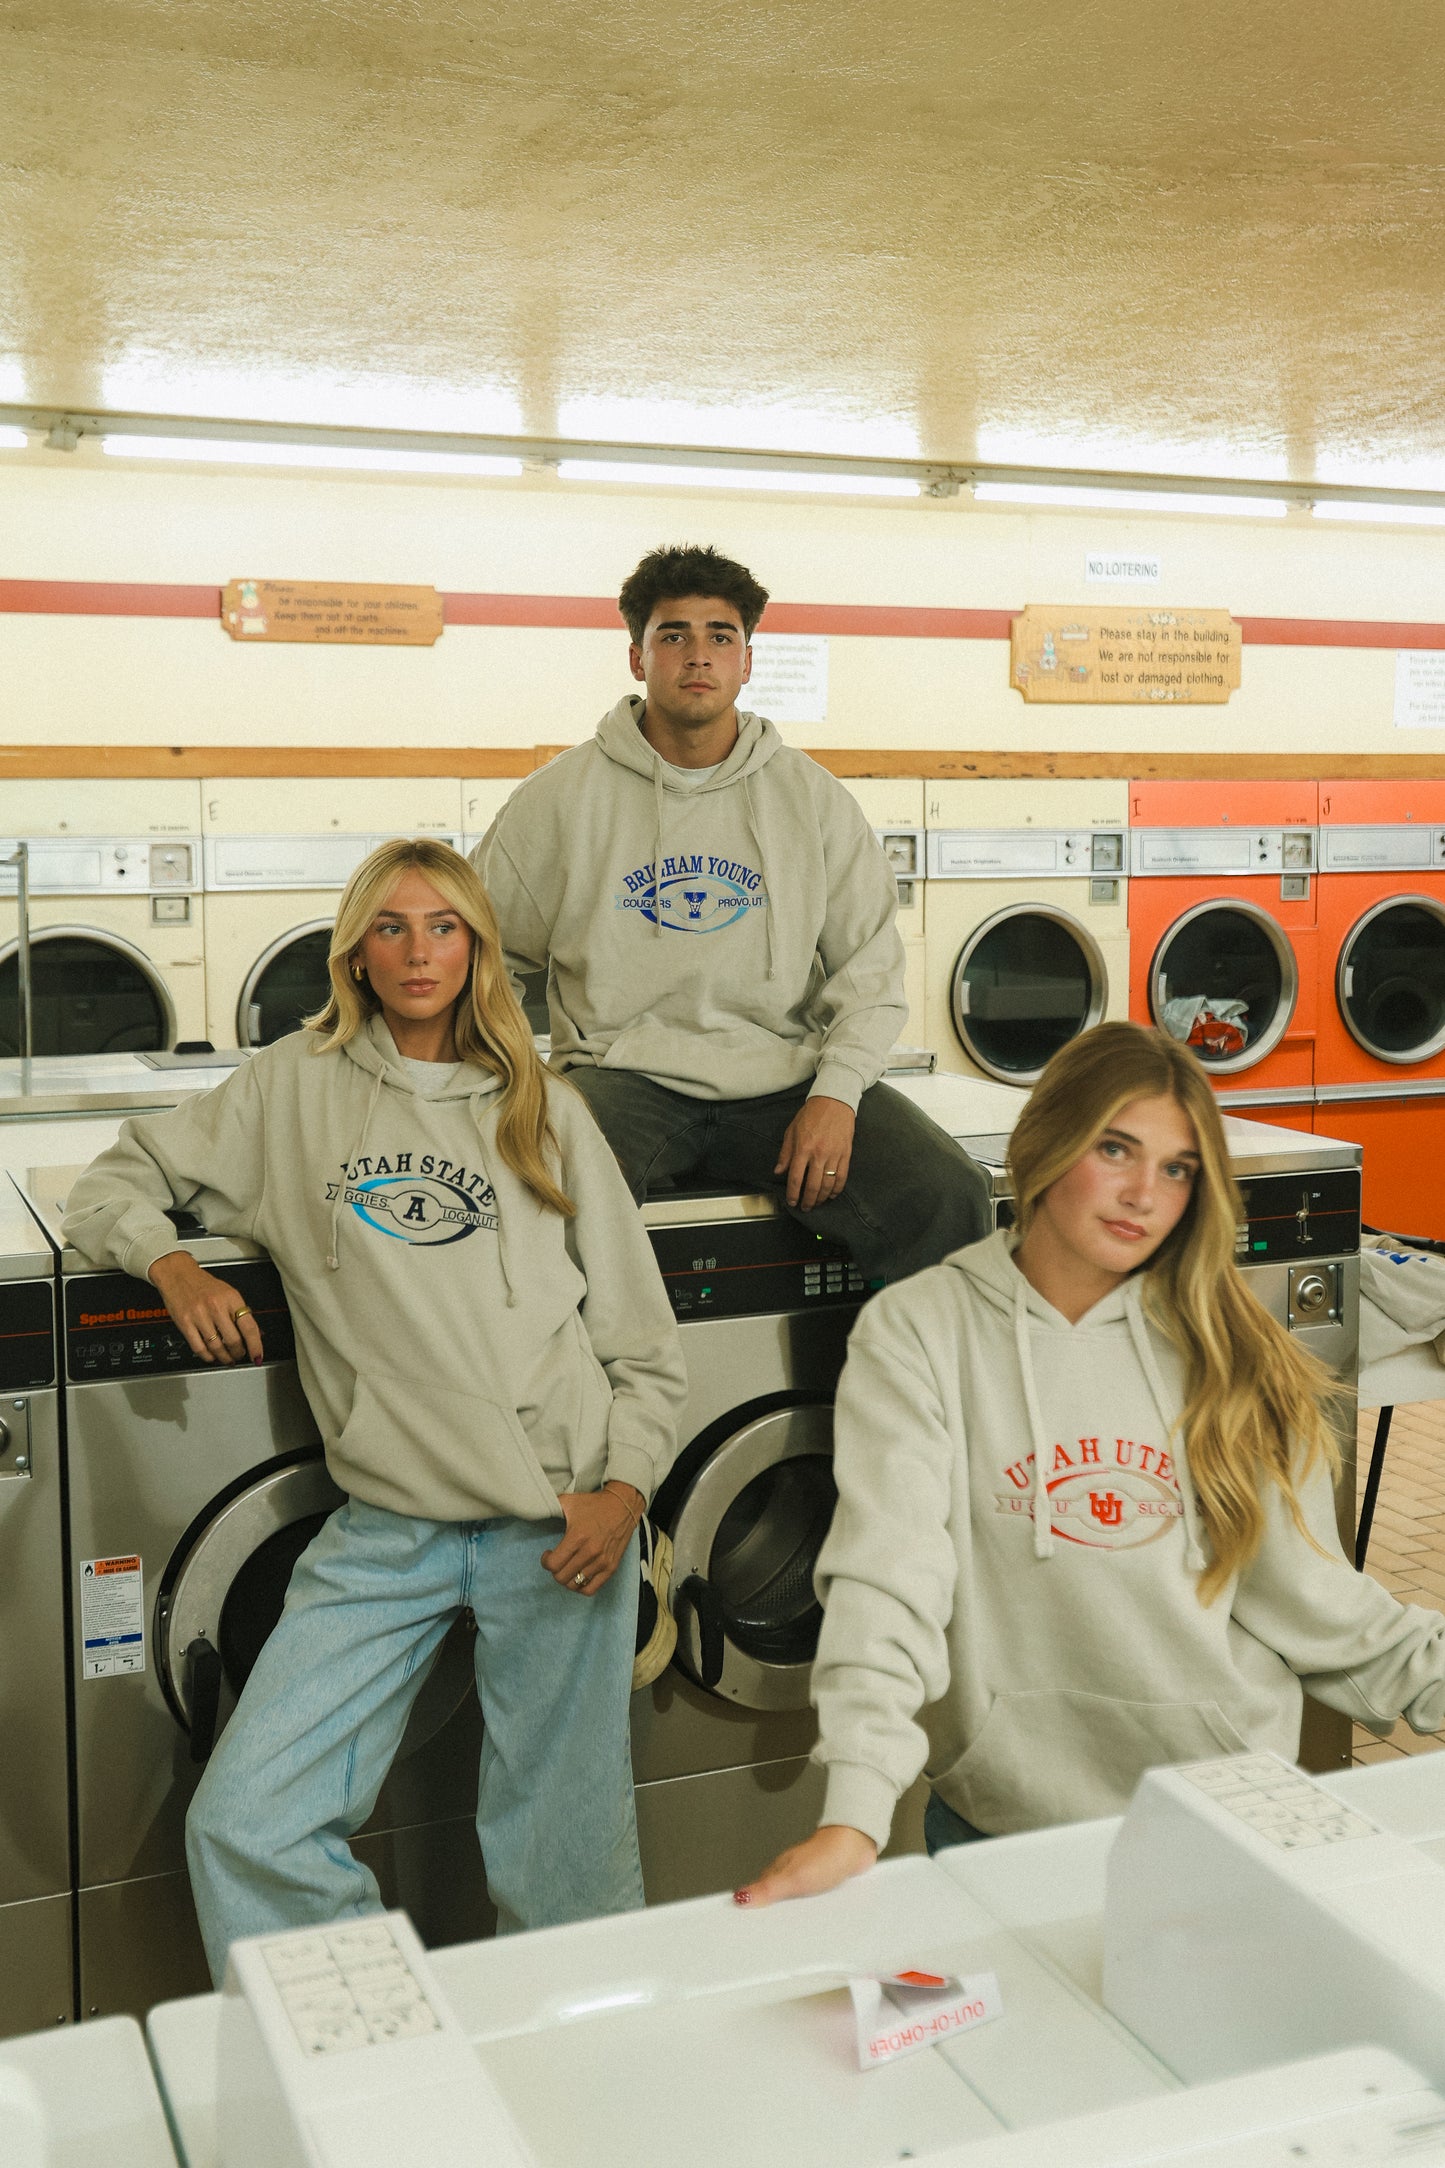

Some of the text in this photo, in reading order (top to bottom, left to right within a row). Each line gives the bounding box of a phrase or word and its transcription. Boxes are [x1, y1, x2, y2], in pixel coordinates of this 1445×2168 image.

[1088, 561, 1158, 578] NO LOITERING
[279, 598, 289, 606] be
[294, 598, 343, 609] responsible
[347, 600, 359, 608] for
[362, 601, 382, 611] your
[274, 612, 297, 622] Keep
[301, 612, 322, 621] them
[326, 613, 340, 621] out
[314, 626, 331, 634] and
[334, 626, 349, 634] off
[350, 626, 364, 635] the
[1100, 628, 1232, 643] Please stay in the building.
[1100, 650, 1229, 665] We are not responsible for
[1100, 671, 1119, 683] lost
[1124, 673, 1134, 683] or
[1138, 672, 1182, 686] damaged
[209, 801, 218, 821] E
[930, 801, 940, 819] H
[1322, 798, 1331, 816] J
[708, 856, 762, 891] YOUNG
[340, 1153, 496, 1207] UTAH STATE
[403, 1197, 426, 1222] A
[80, 1309, 169, 1326] Speed Queen
[1115, 1439, 1181, 1492] UTE
[105, 1558, 136, 1567] WARNING
[869, 2000, 986, 2058] OUT-OF-ORDER
